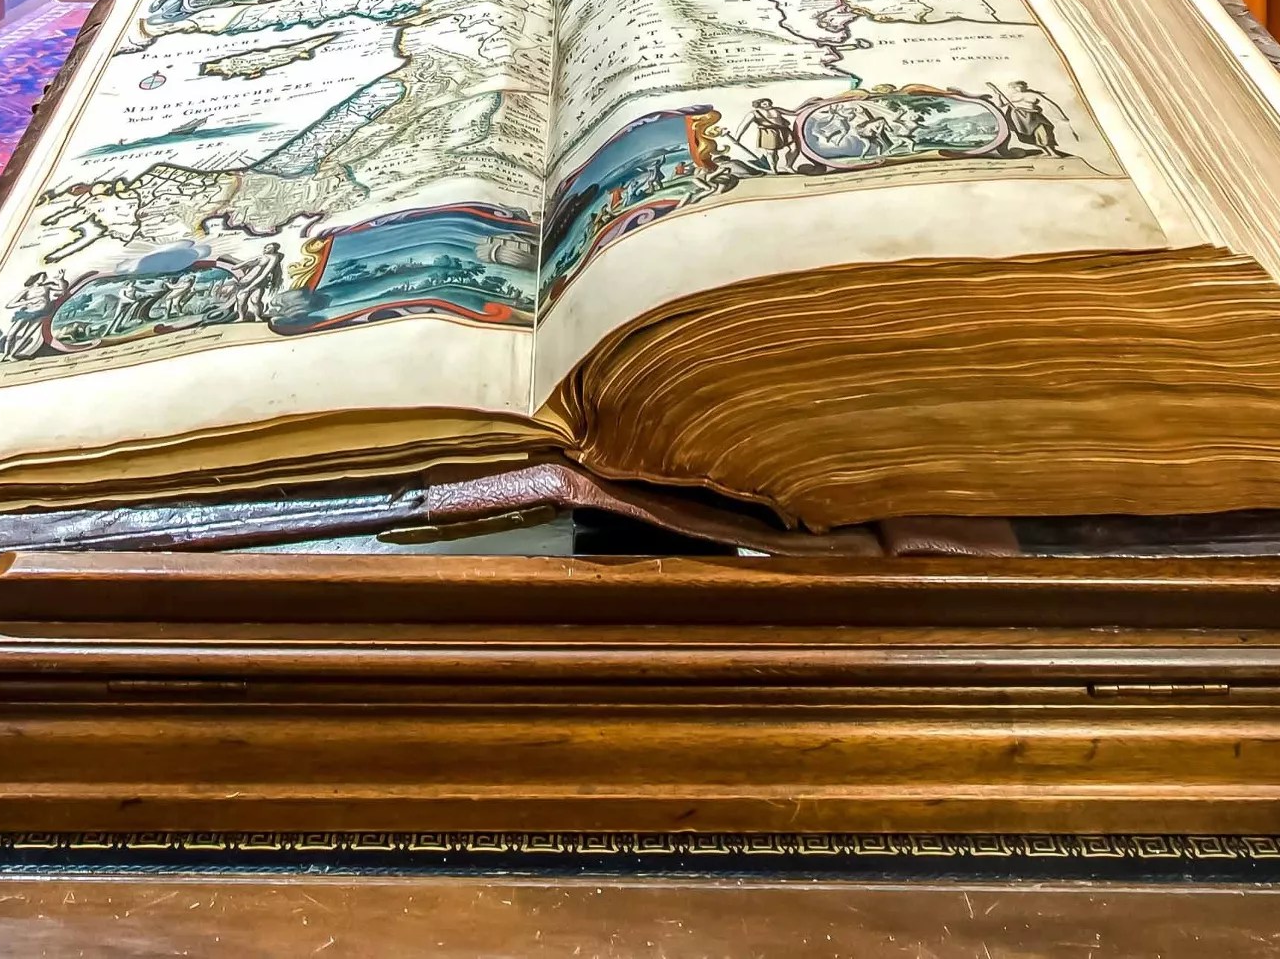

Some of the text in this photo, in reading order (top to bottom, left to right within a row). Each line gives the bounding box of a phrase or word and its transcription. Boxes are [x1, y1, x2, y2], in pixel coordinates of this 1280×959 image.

[878, 38, 895, 46] DE
[902, 57, 941, 65] SINUS
[123, 86, 274, 114] MIDDELANTSCHE
[280, 81, 313, 92] ZEE
[182, 96, 281, 117] GROOTE ZEE
[364, 157, 418, 172] ARABIEN
